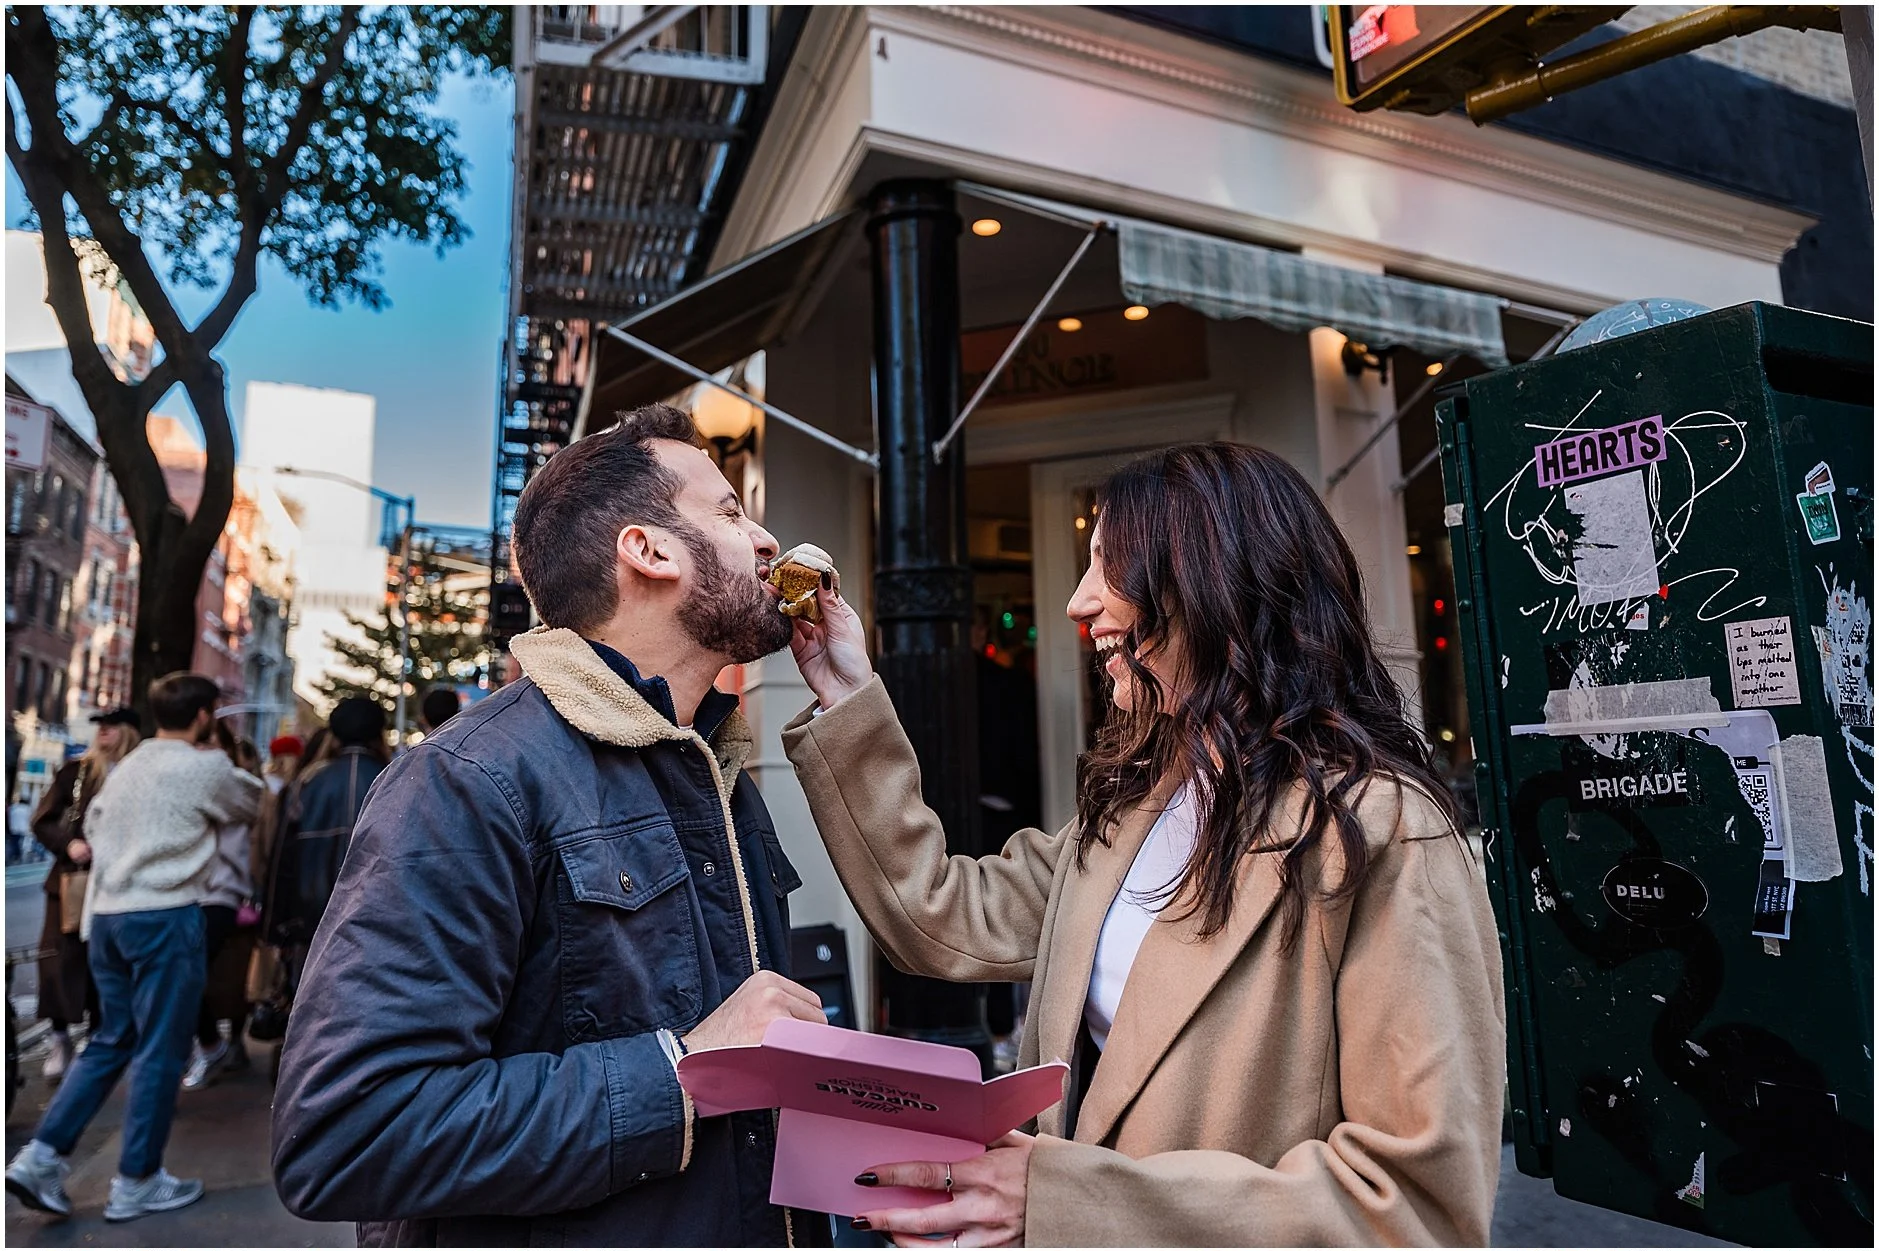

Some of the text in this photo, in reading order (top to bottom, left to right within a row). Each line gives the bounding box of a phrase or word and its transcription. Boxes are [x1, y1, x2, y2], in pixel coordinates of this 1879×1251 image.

[1541, 421, 1661, 482] HEARTS
[1734, 623, 1787, 638] I burned
[1758, 652, 1791, 665] melted
[1741, 669, 1760, 681] into
[1741, 683, 1783, 694] another
[1580, 770, 1687, 799] BRIGADE
[1616, 884, 1665, 899] DELU
[827, 1078, 920, 1100] BAKESHOP
[815, 1082, 940, 1112] CUPCAKE
